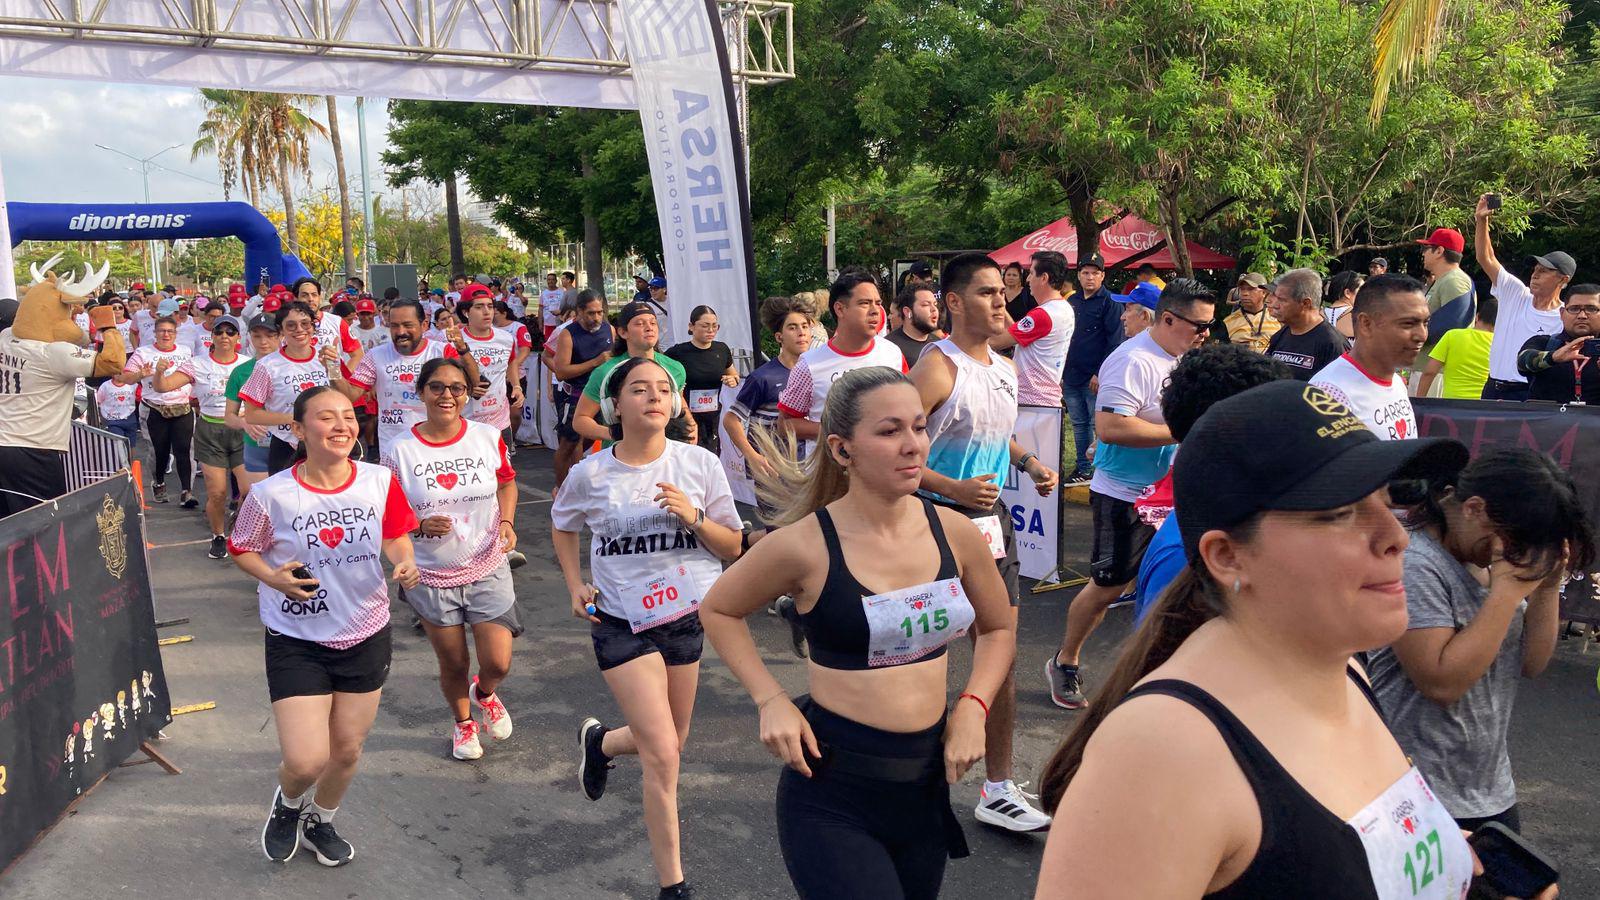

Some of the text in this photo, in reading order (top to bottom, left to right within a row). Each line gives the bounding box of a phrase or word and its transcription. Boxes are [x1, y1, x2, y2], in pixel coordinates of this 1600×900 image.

[69, 213, 186, 232] dportenis
[413, 457, 486, 477] CARRERA
[291, 506, 377, 532] CARRERA
[319, 557, 332, 568] 5K
[642, 585, 679, 610] 070
[900, 608, 950, 638] 115
[1403, 828, 1443, 897] 127
